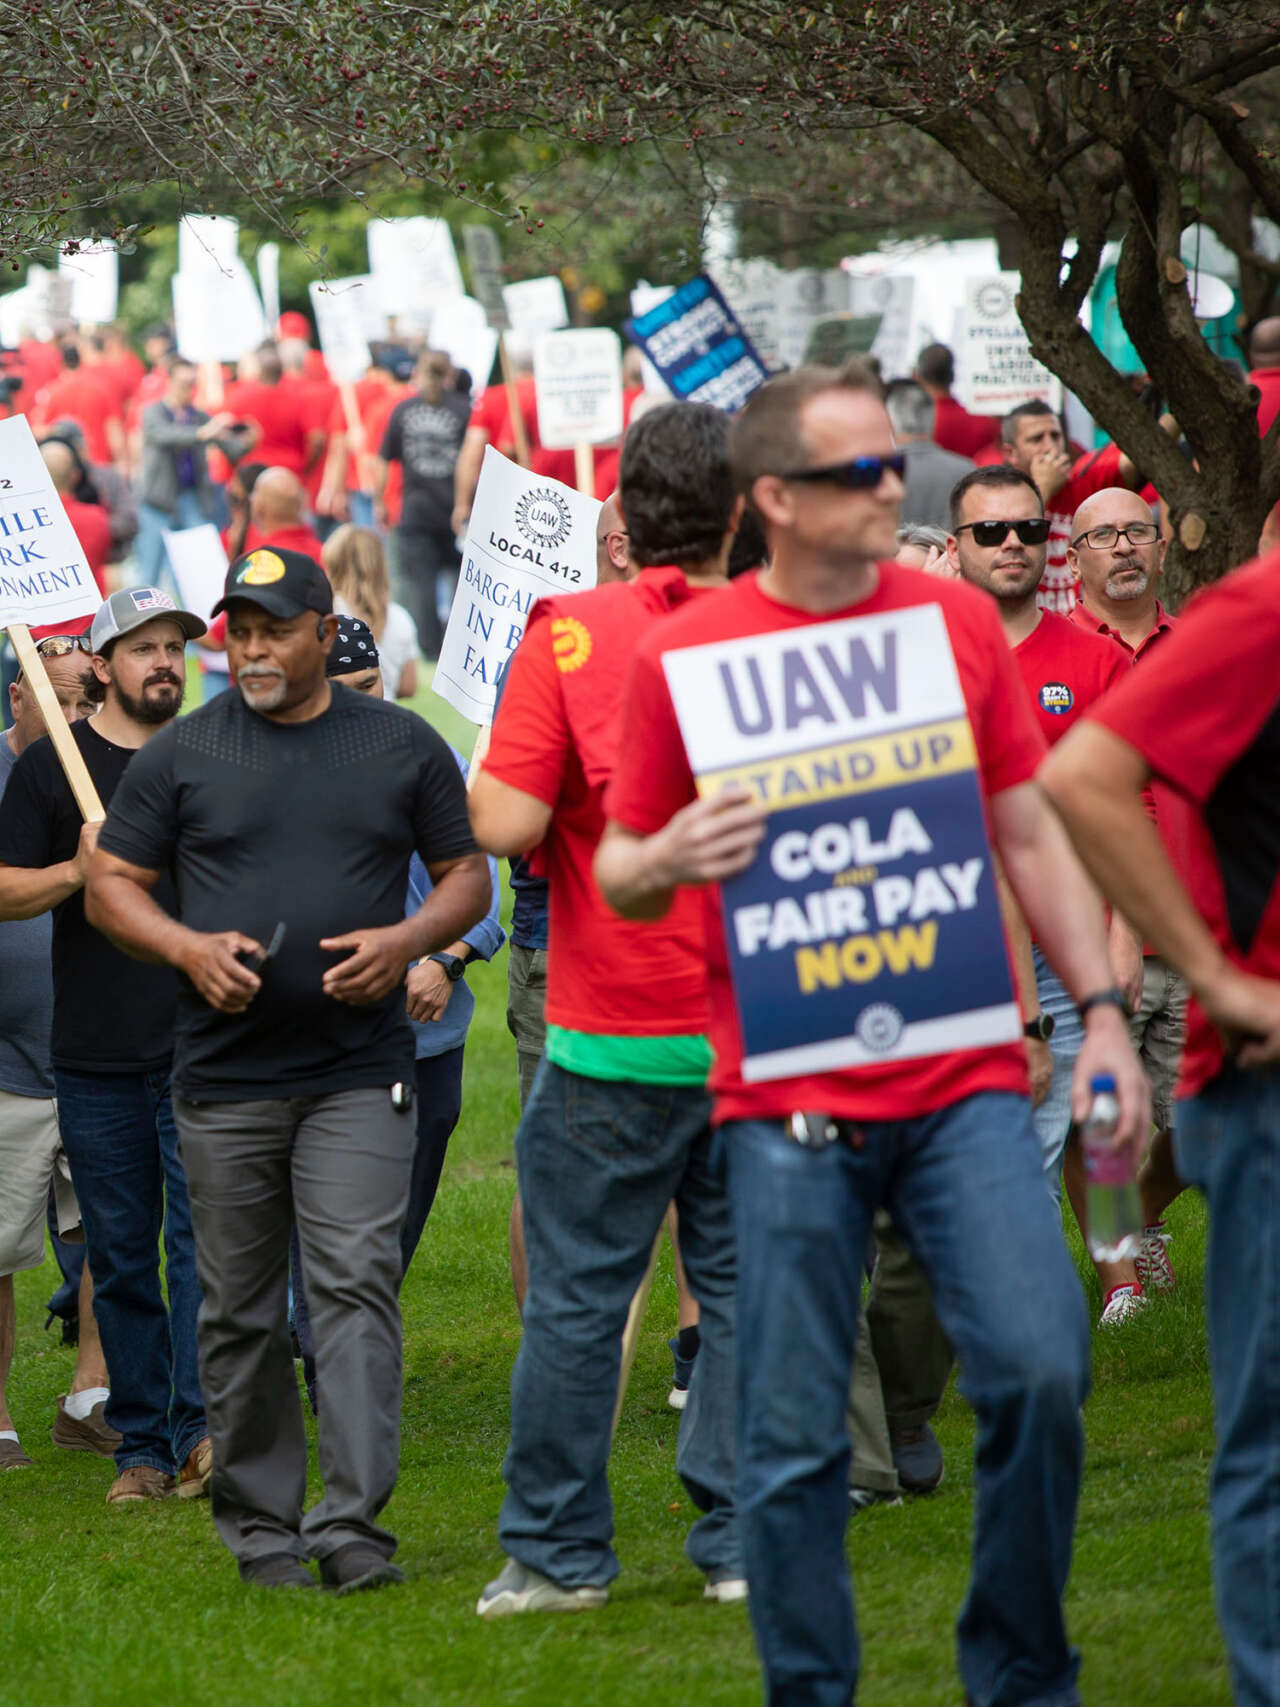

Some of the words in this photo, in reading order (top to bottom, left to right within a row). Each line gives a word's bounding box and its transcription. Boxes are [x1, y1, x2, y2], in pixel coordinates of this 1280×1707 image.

[530, 507, 559, 529] UAW
[489, 532, 545, 568] LOCAL
[549, 564, 582, 584] 412
[465, 558, 533, 616] BARGAI
[466, 600, 495, 643] IN
[463, 644, 504, 686] FAI
[719, 630, 899, 737] UAW
[1043, 686, 1068, 696] 97%
[894, 734, 954, 771] UP
[770, 807, 932, 881] COLA
[835, 866, 878, 888] AND
[733, 875, 868, 957] FAIR
[873, 858, 984, 926] PAY
[795, 921, 938, 994] NOW
